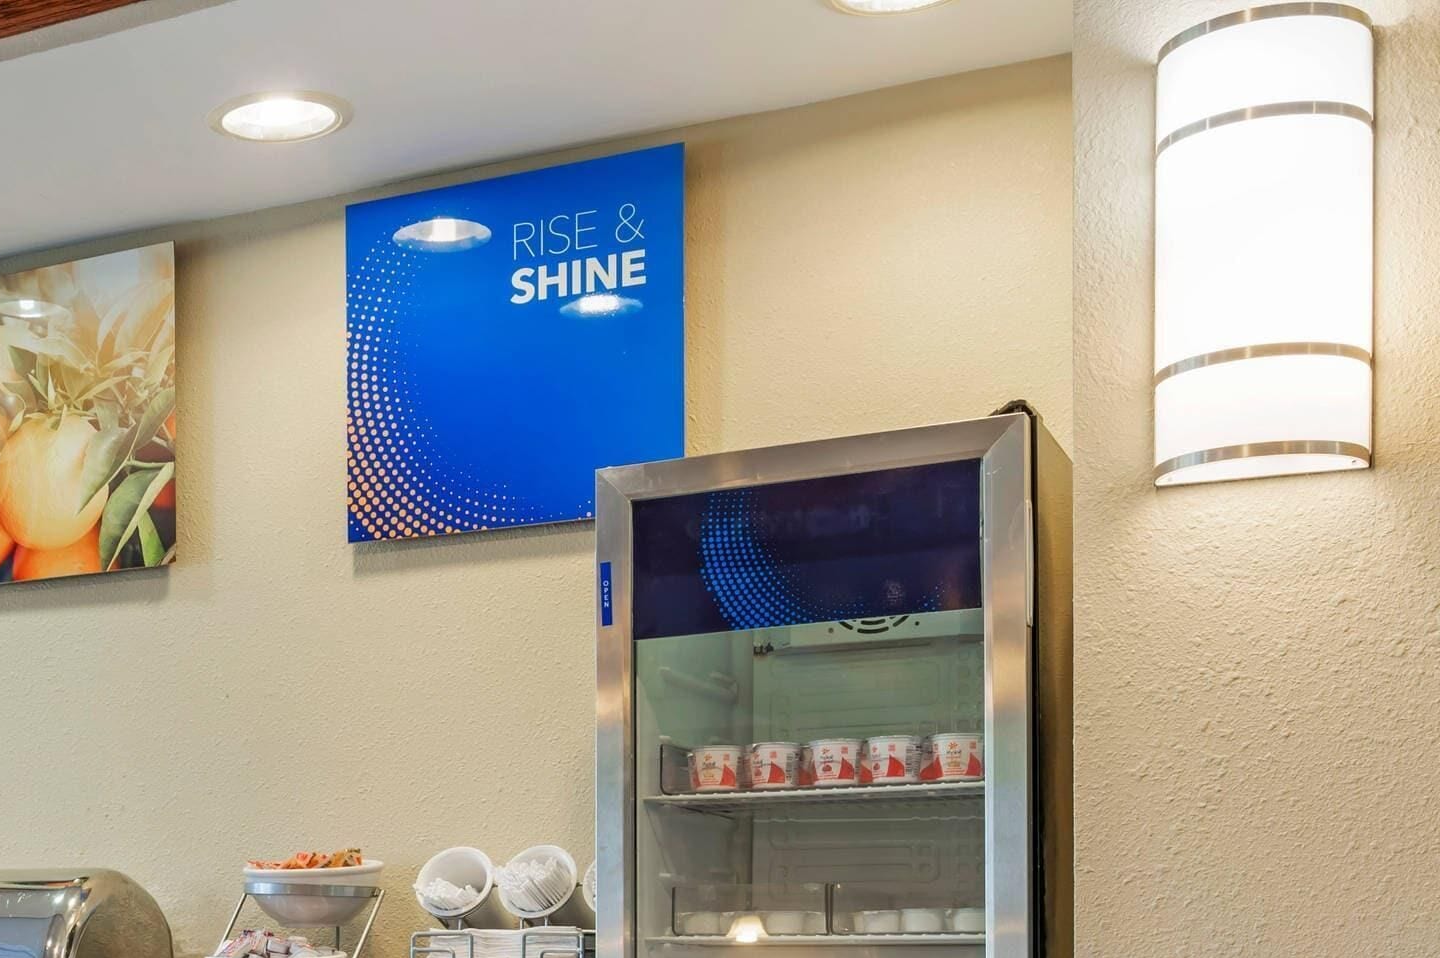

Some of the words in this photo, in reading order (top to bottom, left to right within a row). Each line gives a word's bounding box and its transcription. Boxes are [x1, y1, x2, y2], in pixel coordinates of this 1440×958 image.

[513, 210, 598, 261] RISE
[615, 203, 645, 243] &
[510, 249, 646, 304] SHINE
